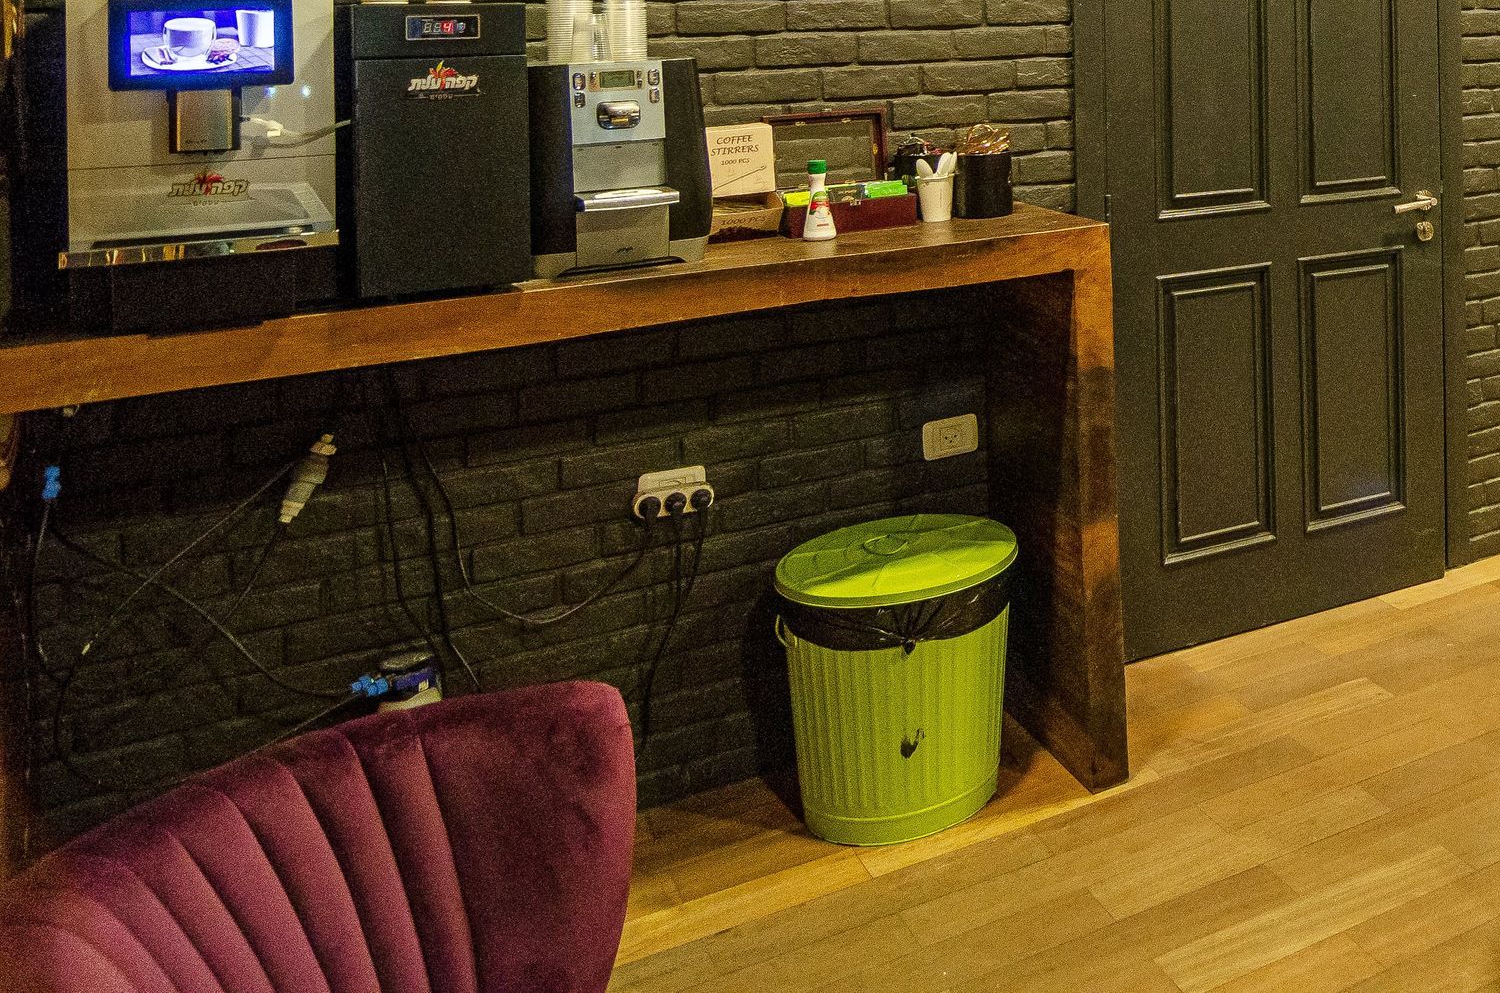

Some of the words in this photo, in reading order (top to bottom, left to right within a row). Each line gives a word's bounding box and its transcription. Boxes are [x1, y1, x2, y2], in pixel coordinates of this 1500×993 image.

[445, 74, 479, 90] קפה
[716, 134, 754, 145] COFFEE
[711, 144, 760, 156] STIRRERS
[210, 179, 250, 196] קפה
[721, 217, 746, 226] 1000
